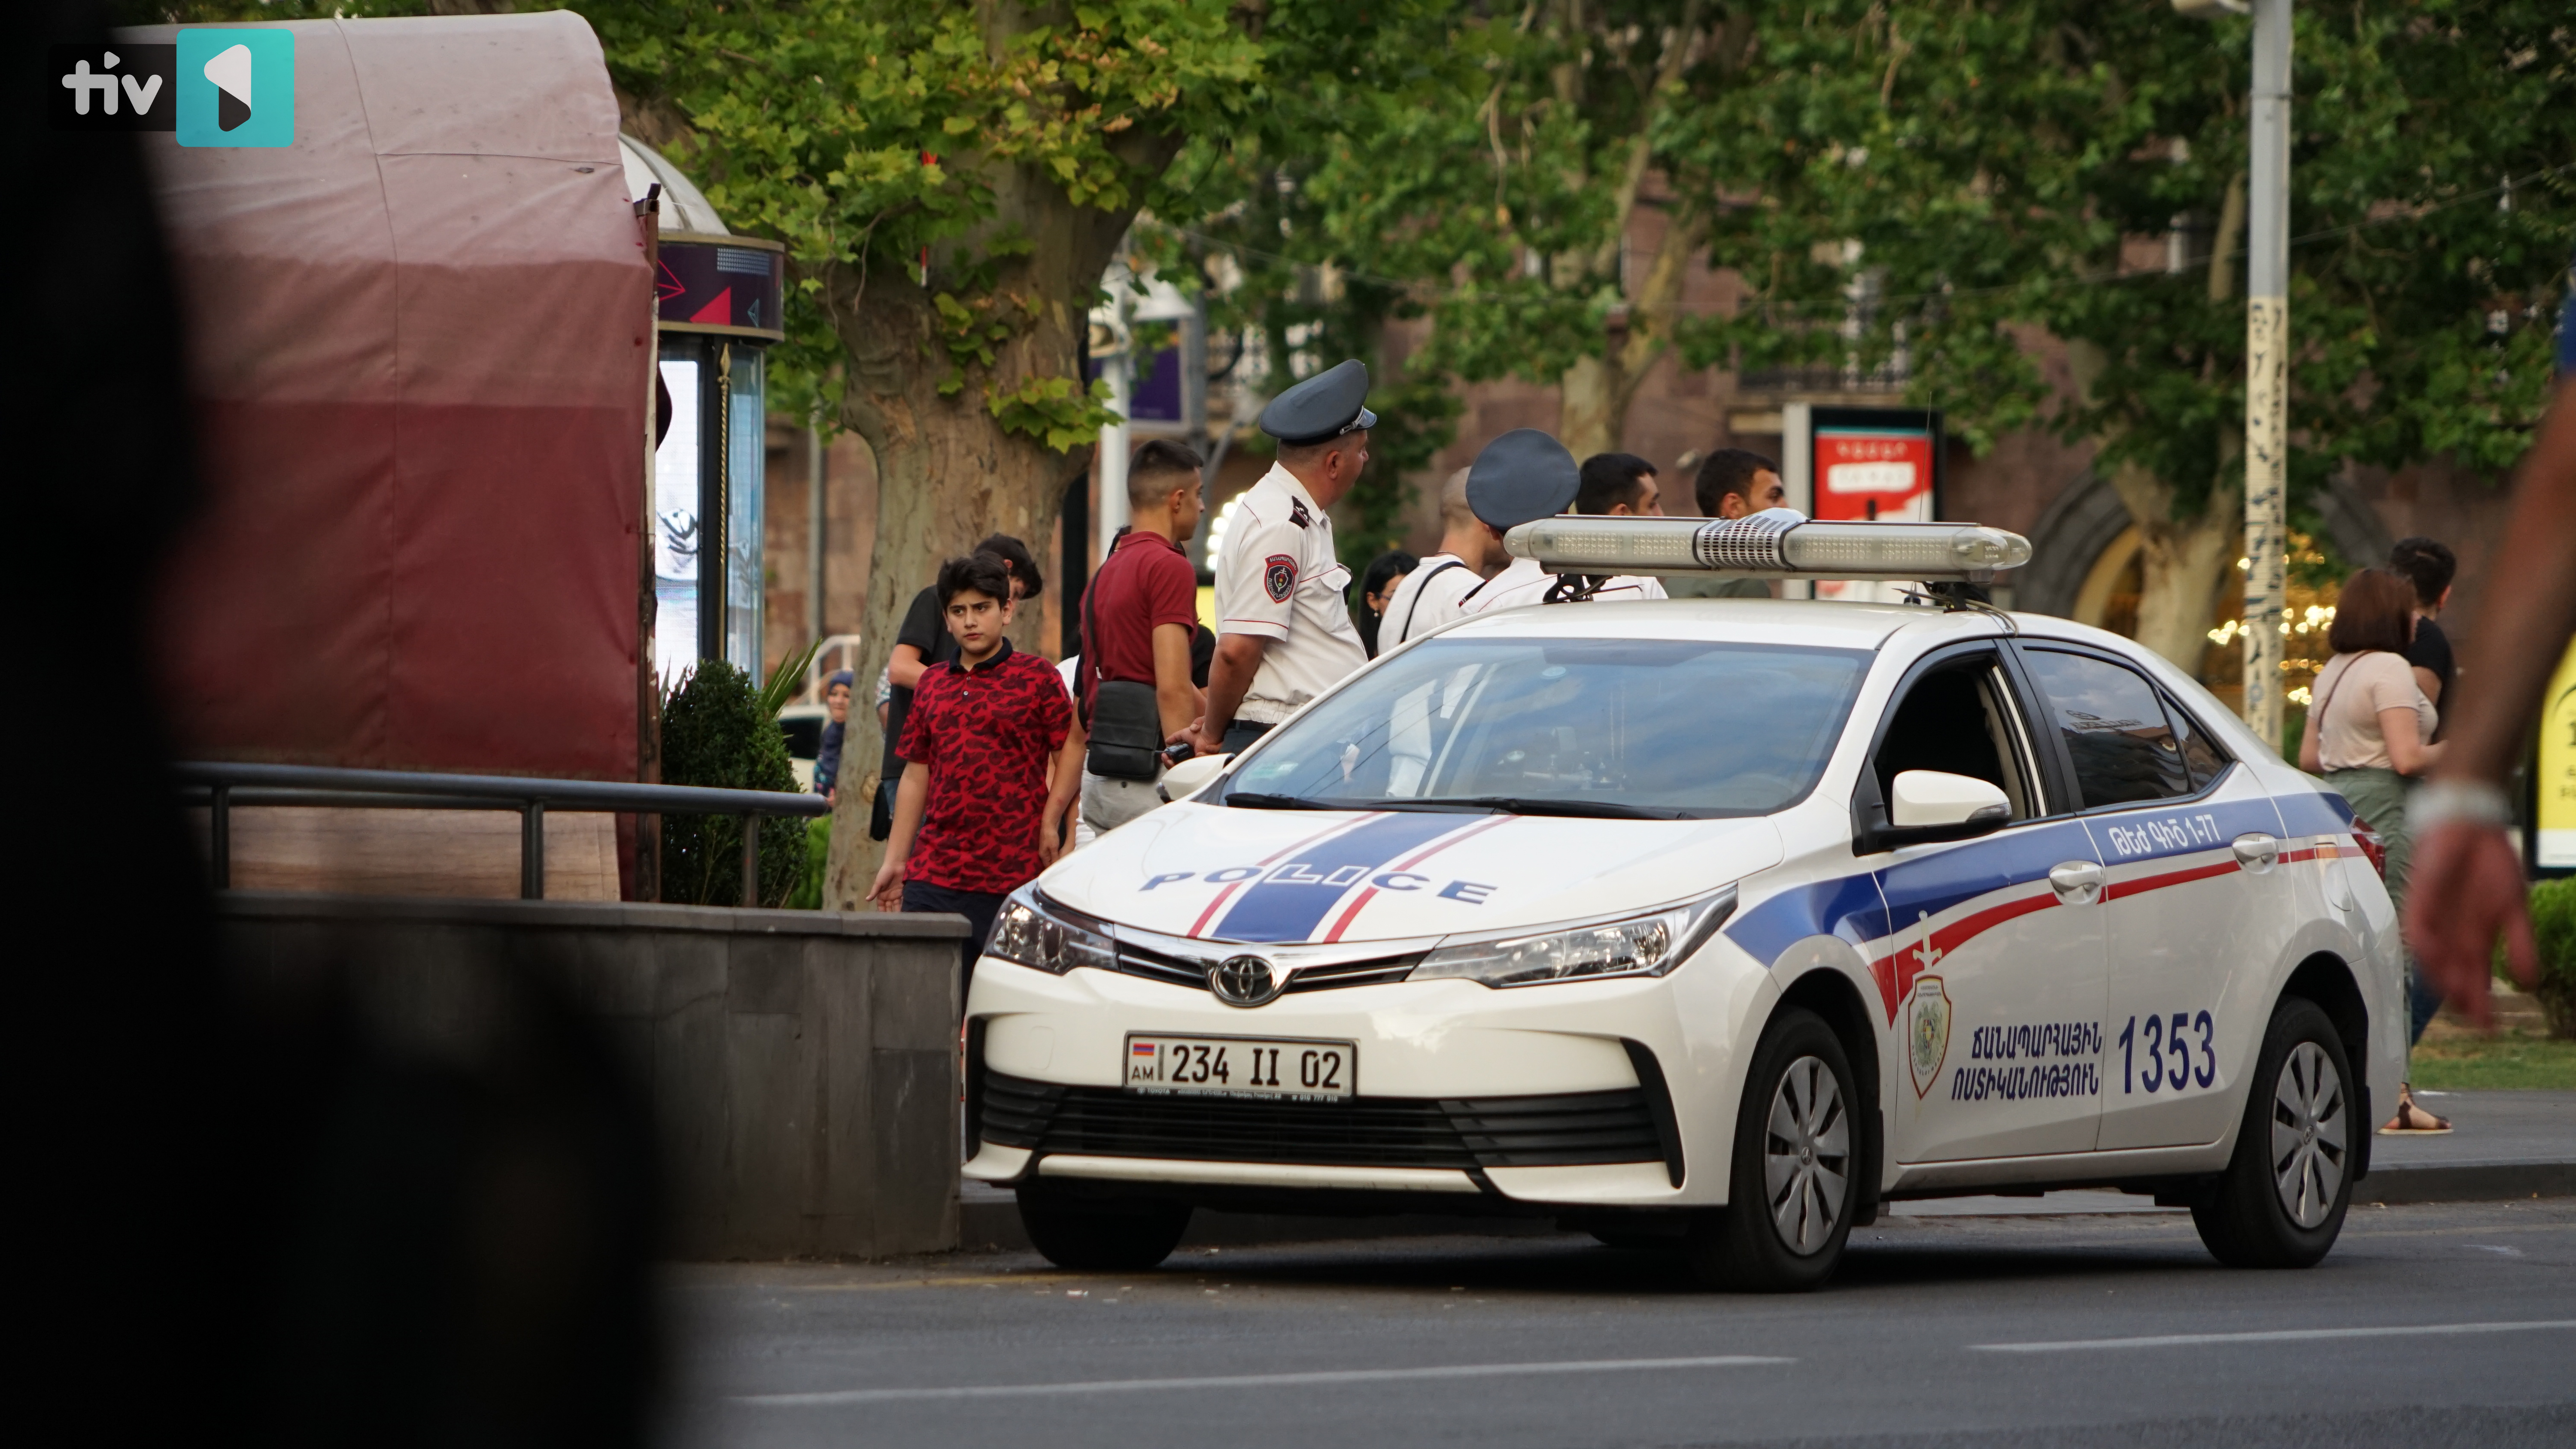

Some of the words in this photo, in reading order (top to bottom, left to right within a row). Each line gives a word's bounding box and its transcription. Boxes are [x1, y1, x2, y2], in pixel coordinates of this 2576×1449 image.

[1138, 864, 1498, 904] POLICE
[1971, 1022, 2102, 1060] ՃԱՆԱՊԱՐՀԱՅԻՆ
[2119, 1010, 2216, 1094] 1353
[1131, 1065, 1154, 1081] AM
[1172, 1045, 1229, 1084] 234
[1250, 1048, 1279, 1086] II
[1301, 1050, 1341, 1088] 02
[1951, 1063, 2099, 1101] ՈՍՏԻԿԱՆՈՒԹՅՈՒՆ
